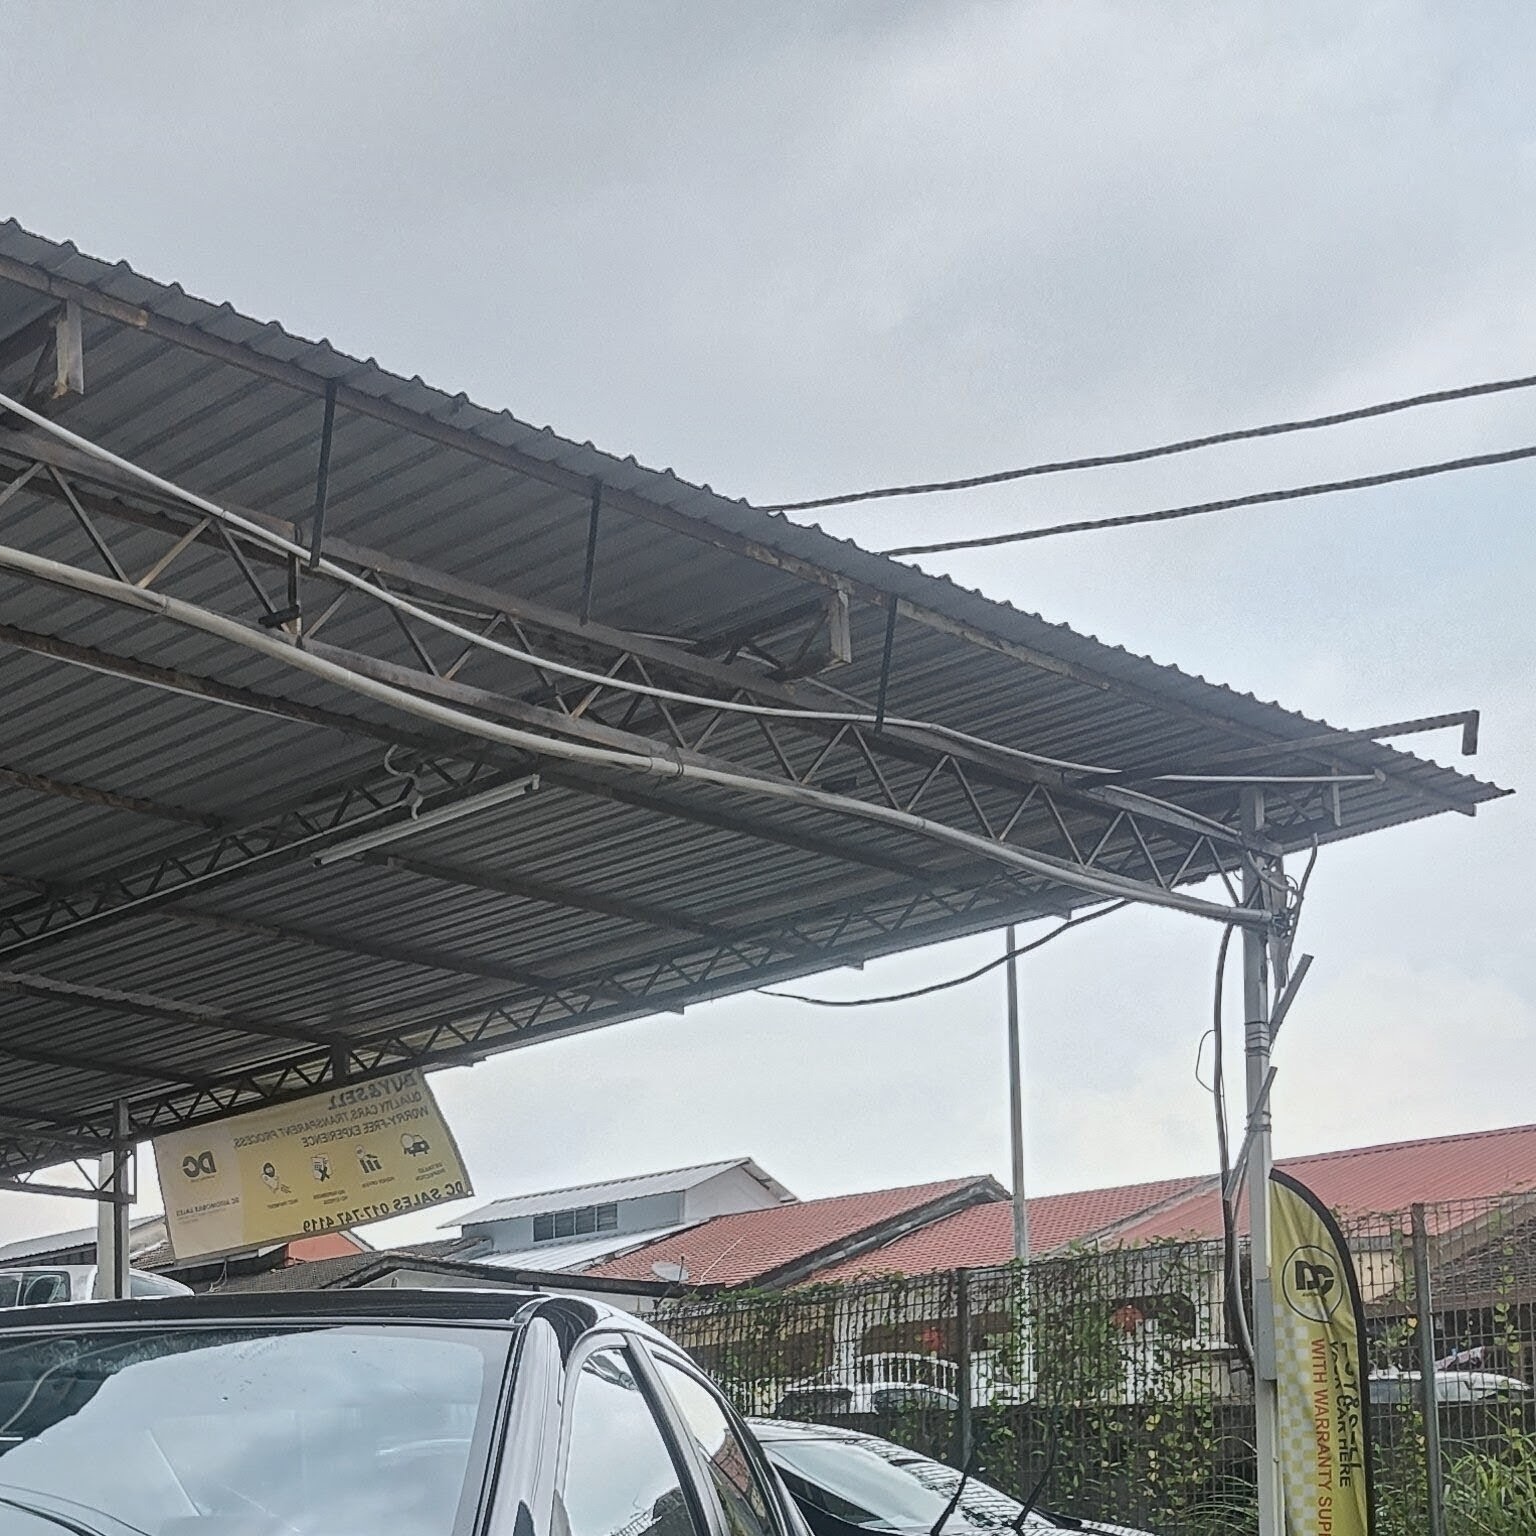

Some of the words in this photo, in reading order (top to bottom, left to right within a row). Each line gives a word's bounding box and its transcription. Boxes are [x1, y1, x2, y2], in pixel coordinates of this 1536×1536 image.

[1312, 1338, 1327, 1383] WITH
[1314, 1389, 1332, 1491] WARRANTY
[1338, 1439, 1351, 1488] HERE
